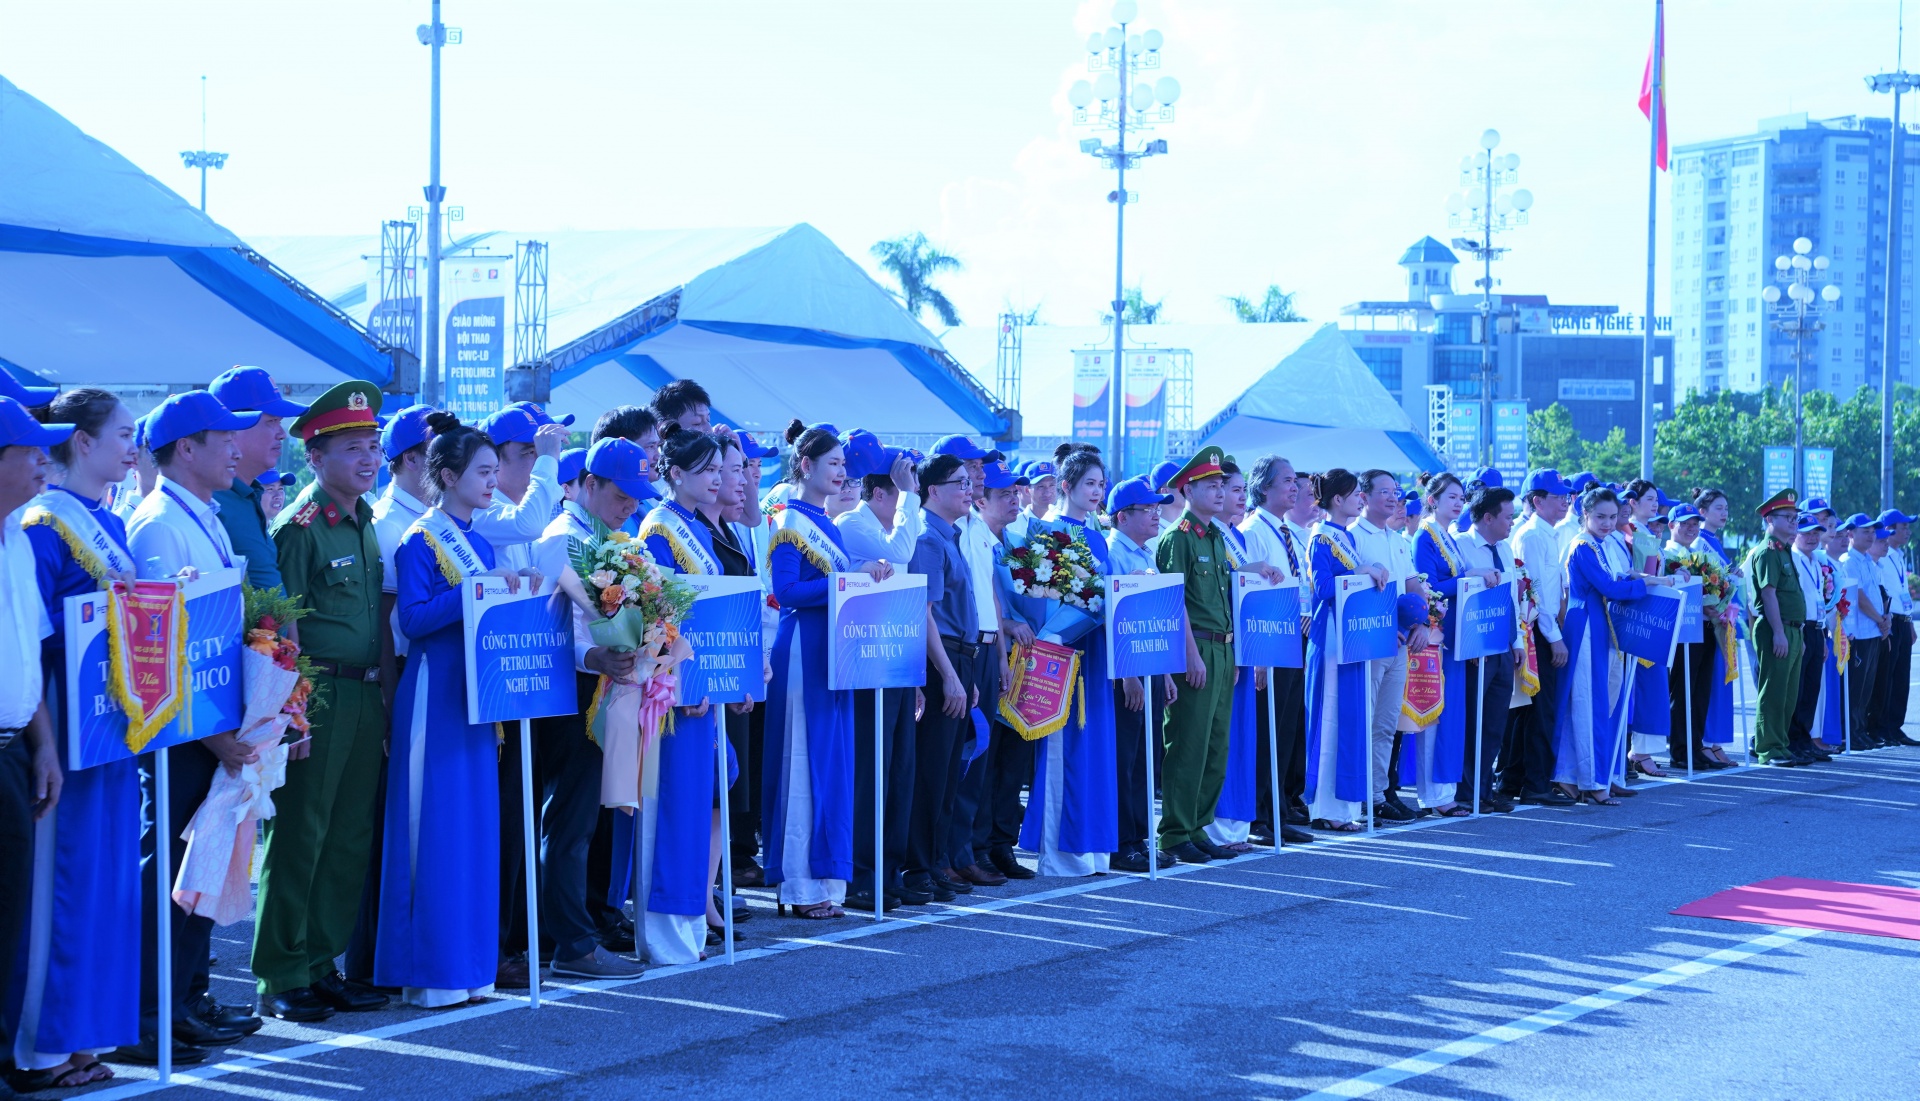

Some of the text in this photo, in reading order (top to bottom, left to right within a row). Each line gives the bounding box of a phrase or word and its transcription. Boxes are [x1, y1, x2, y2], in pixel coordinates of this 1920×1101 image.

[452, 315, 496, 328] CHÀO MỪNG
[1639, 315, 1672, 331] TNH
[457, 333, 490, 347] HỘI THAO
[451, 366, 496, 378] PETROLIMEX
[457, 383, 489, 397] KHU VỰC
[464, 401, 487, 412] TRUNG
[676, 525, 689, 540] TẬP
[688, 538, 705, 561] ĐOÀN
[808, 528, 821, 544] TẬP
[820, 540, 836, 560] ĐOÀN
[1347, 611, 1393, 633] TỔ TRỌNG TÀI
[1466, 608, 1479, 622] CÔNG
[1479, 609, 1485, 620] TY
[1485, 606, 1497, 619] XĂNG
[1612, 601, 1630, 618] CÔNG
[1630, 607, 1639, 620] TY
[1638, 608, 1657, 626] XĂNG
[1657, 616, 1673, 631] DẦU
[843, 620, 920, 639] CÔNG TY XĂNG DẦU
[1117, 614, 1180, 635] CÔNG TY XĂNG DẦU
[1246, 615, 1296, 637] TỔ TRỌNG TÀI
[1476, 621, 1495, 635] NGHỆ AN
[1625, 621, 1652, 640] HÀ TĨNH
[203, 635, 225, 658] TY
[482, 630, 507, 650] CÔNG
[508, 634, 520, 649] TY
[544, 628, 556, 647] VÀ
[557, 632, 568, 646] DV
[683, 627, 705, 647] CÔNG
[705, 632, 716, 647] TY
[738, 628, 749, 647] VÀ
[749, 631, 759, 647] VT
[1130, 634, 1169, 654] THANH HÓA
[699, 653, 746, 670] PETROLIMEX
[861, 644, 904, 661] KHU VỰC V
[500, 653, 553, 672] PETROLIMEX
[505, 673, 550, 696] NGHỆ TĨNH
[707, 672, 740, 692] ĐÀ NẴNG
